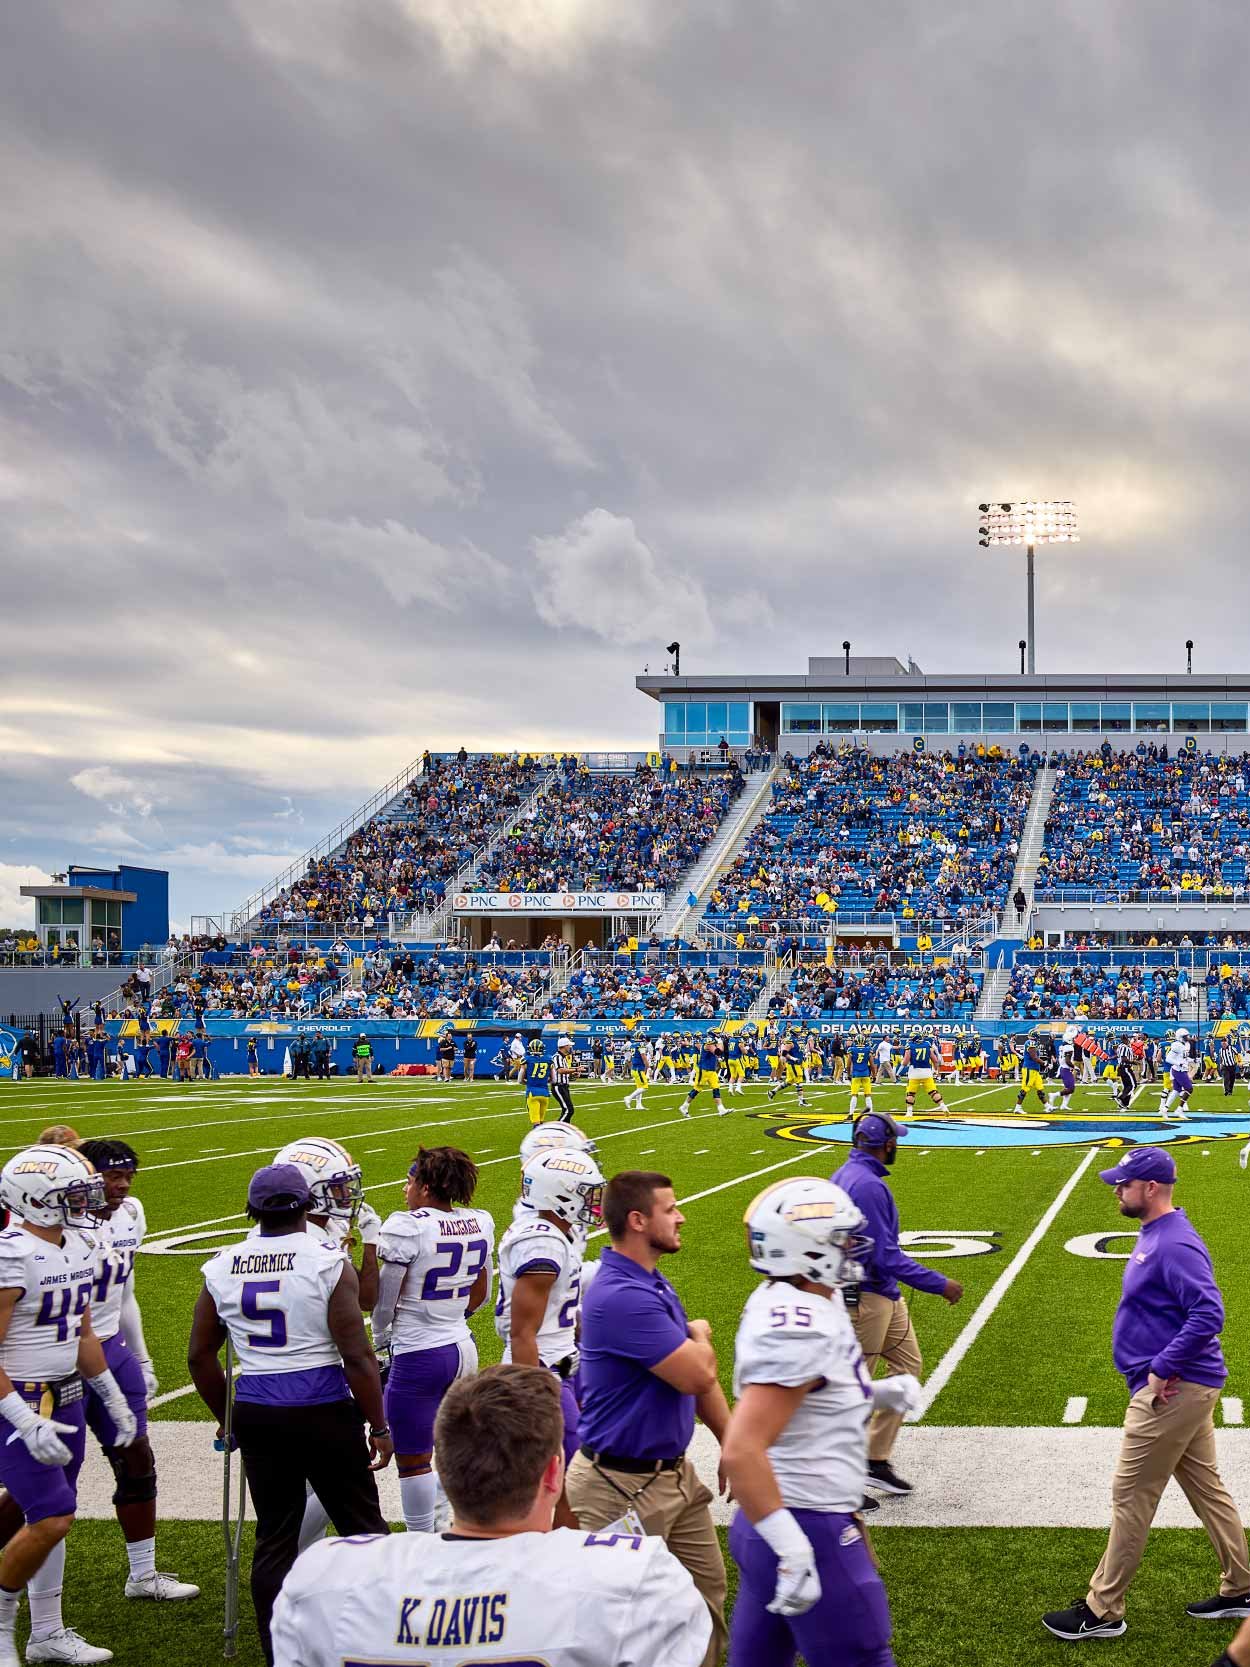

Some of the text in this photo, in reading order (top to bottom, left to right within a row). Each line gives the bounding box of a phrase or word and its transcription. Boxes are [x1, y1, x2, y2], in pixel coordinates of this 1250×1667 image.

[915, 739, 923, 749] C
[1187, 739, 1195, 748] D
[470, 895, 498, 907] PNC
[524, 895, 552, 907] PNC
[578, 895, 606, 907] PNC
[632, 895, 659, 907] PNC
[821, 1023, 979, 1034] DELAWARE FOOTBALL
[915, 1047, 927, 1060] 71
[532, 1062, 549, 1079] 13
[547, 1159, 586, 1176] JMU
[231, 1252, 297, 1275] McCORMICK
[420, 1238, 488, 1301] 23
[40, 1273, 68, 1286] JAMES
[36, 1283, 93, 1342] 49
[240, 1279, 288, 1348] 5
[770, 1306, 813, 1328] 55
[396, 1593, 507, 1646] K. DAVIS
